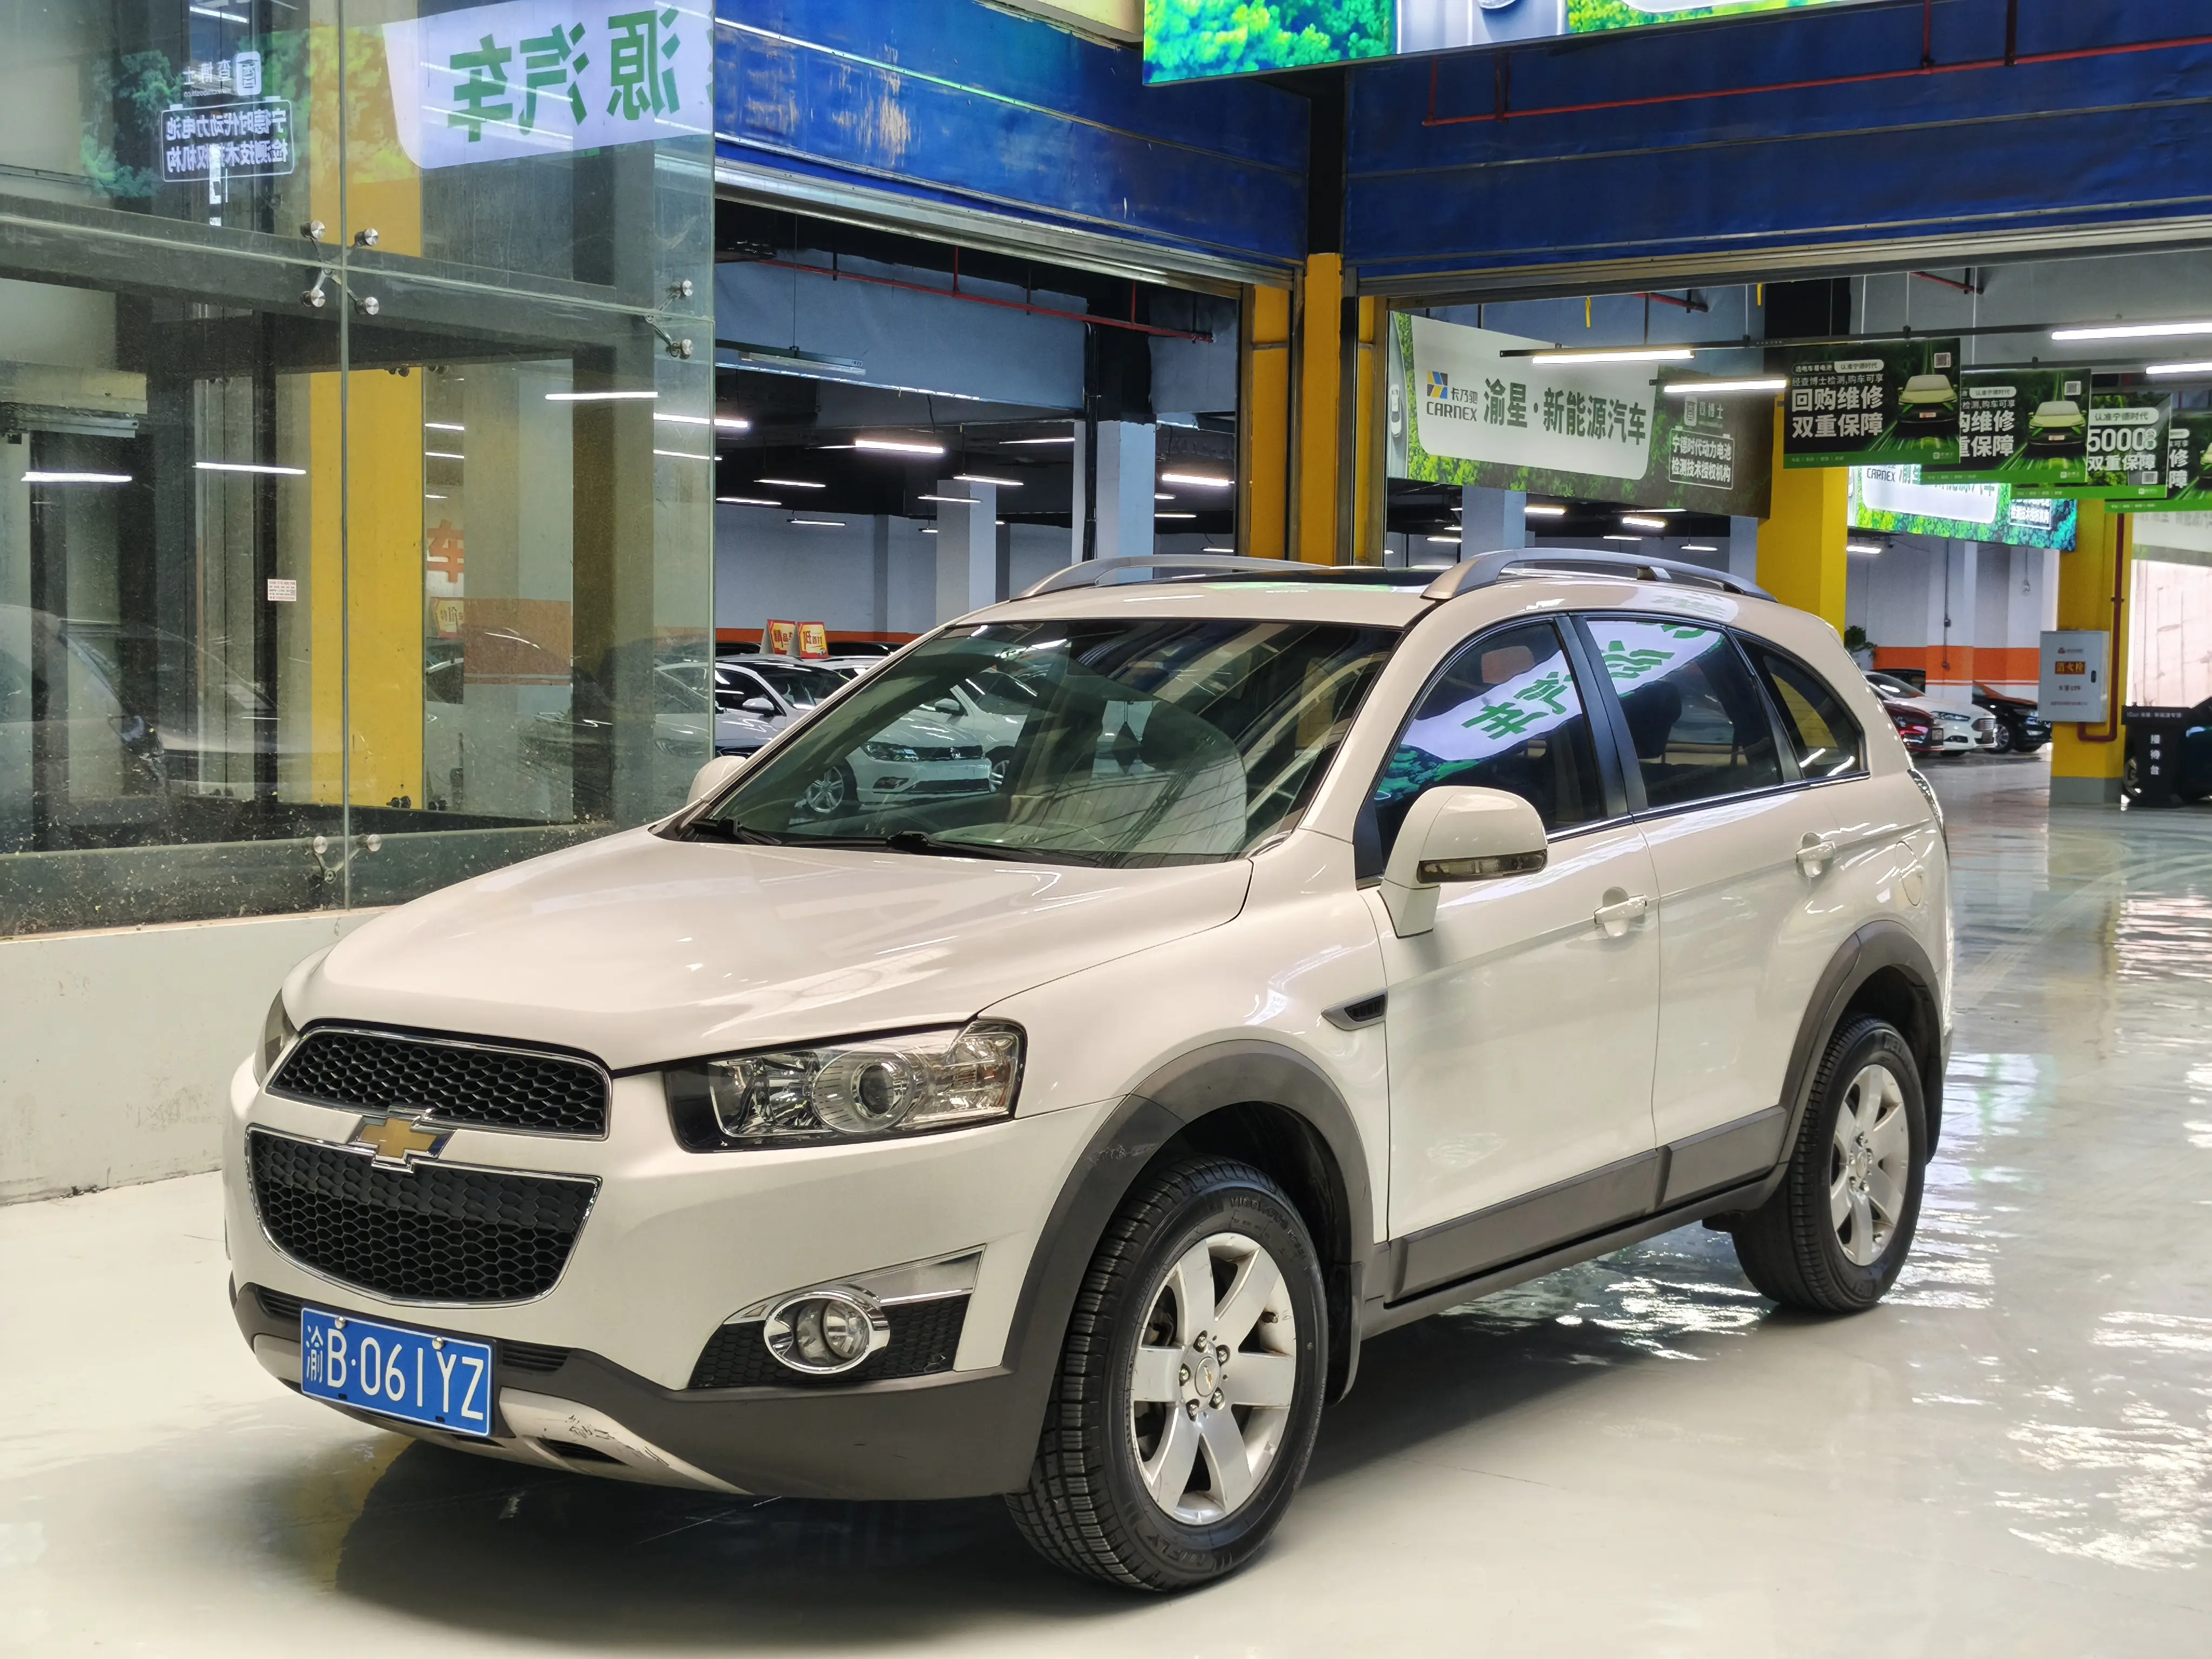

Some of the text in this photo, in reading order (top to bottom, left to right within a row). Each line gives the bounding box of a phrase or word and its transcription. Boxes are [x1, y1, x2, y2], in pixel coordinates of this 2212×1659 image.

[1426, 401, 1478, 422] CARNEX
[1791, 385, 1884, 412] 回购维修
[1792, 412, 1883, 439] 双重保障
[2088, 453, 2157, 471] 双重保障
[305, 1325, 484, 1421] 渝B·061YZ
